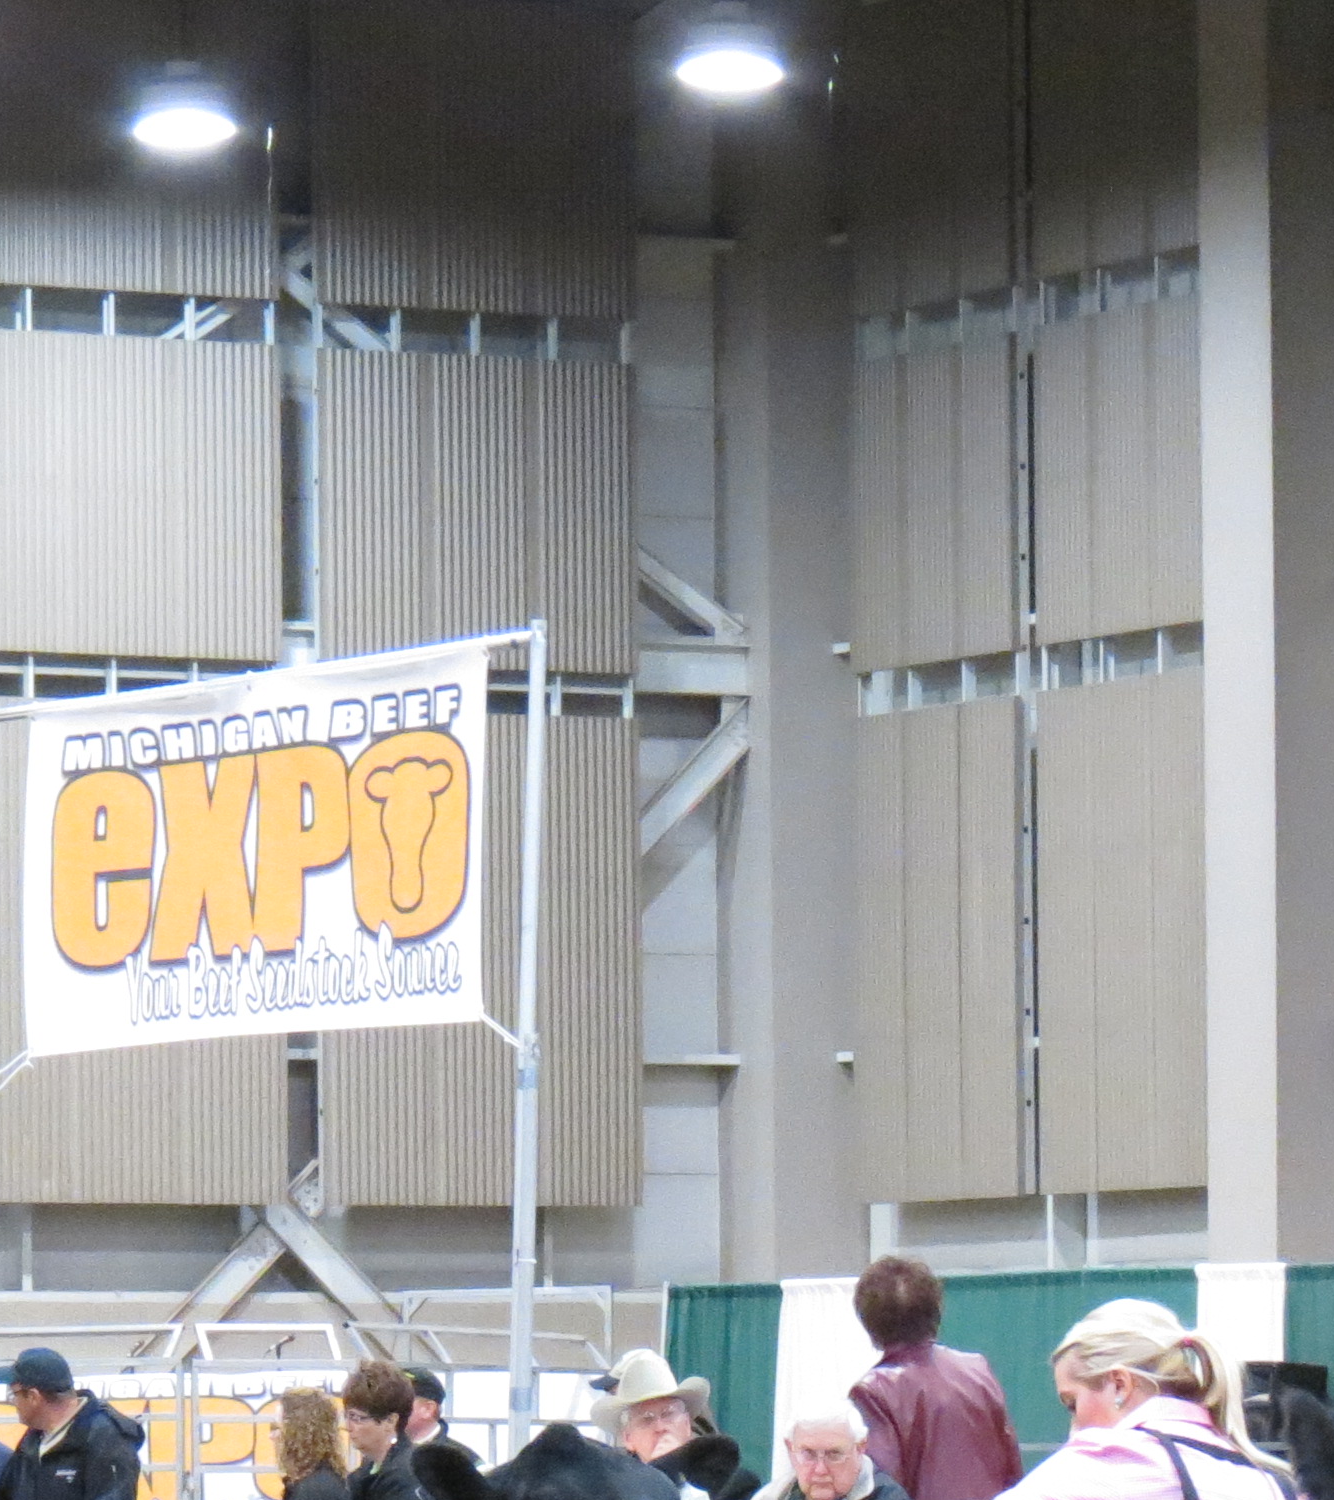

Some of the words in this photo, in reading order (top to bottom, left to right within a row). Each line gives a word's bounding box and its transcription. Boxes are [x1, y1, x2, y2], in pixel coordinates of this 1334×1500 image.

[63, 706, 308, 774] MICHIGAN
[329, 684, 461, 742] BEEF
[125, 952, 181, 1025] Your
[187, 943, 242, 1019] Beef
[246, 927, 370, 1013] Seedstock
[374, 919, 462, 1001] Source
